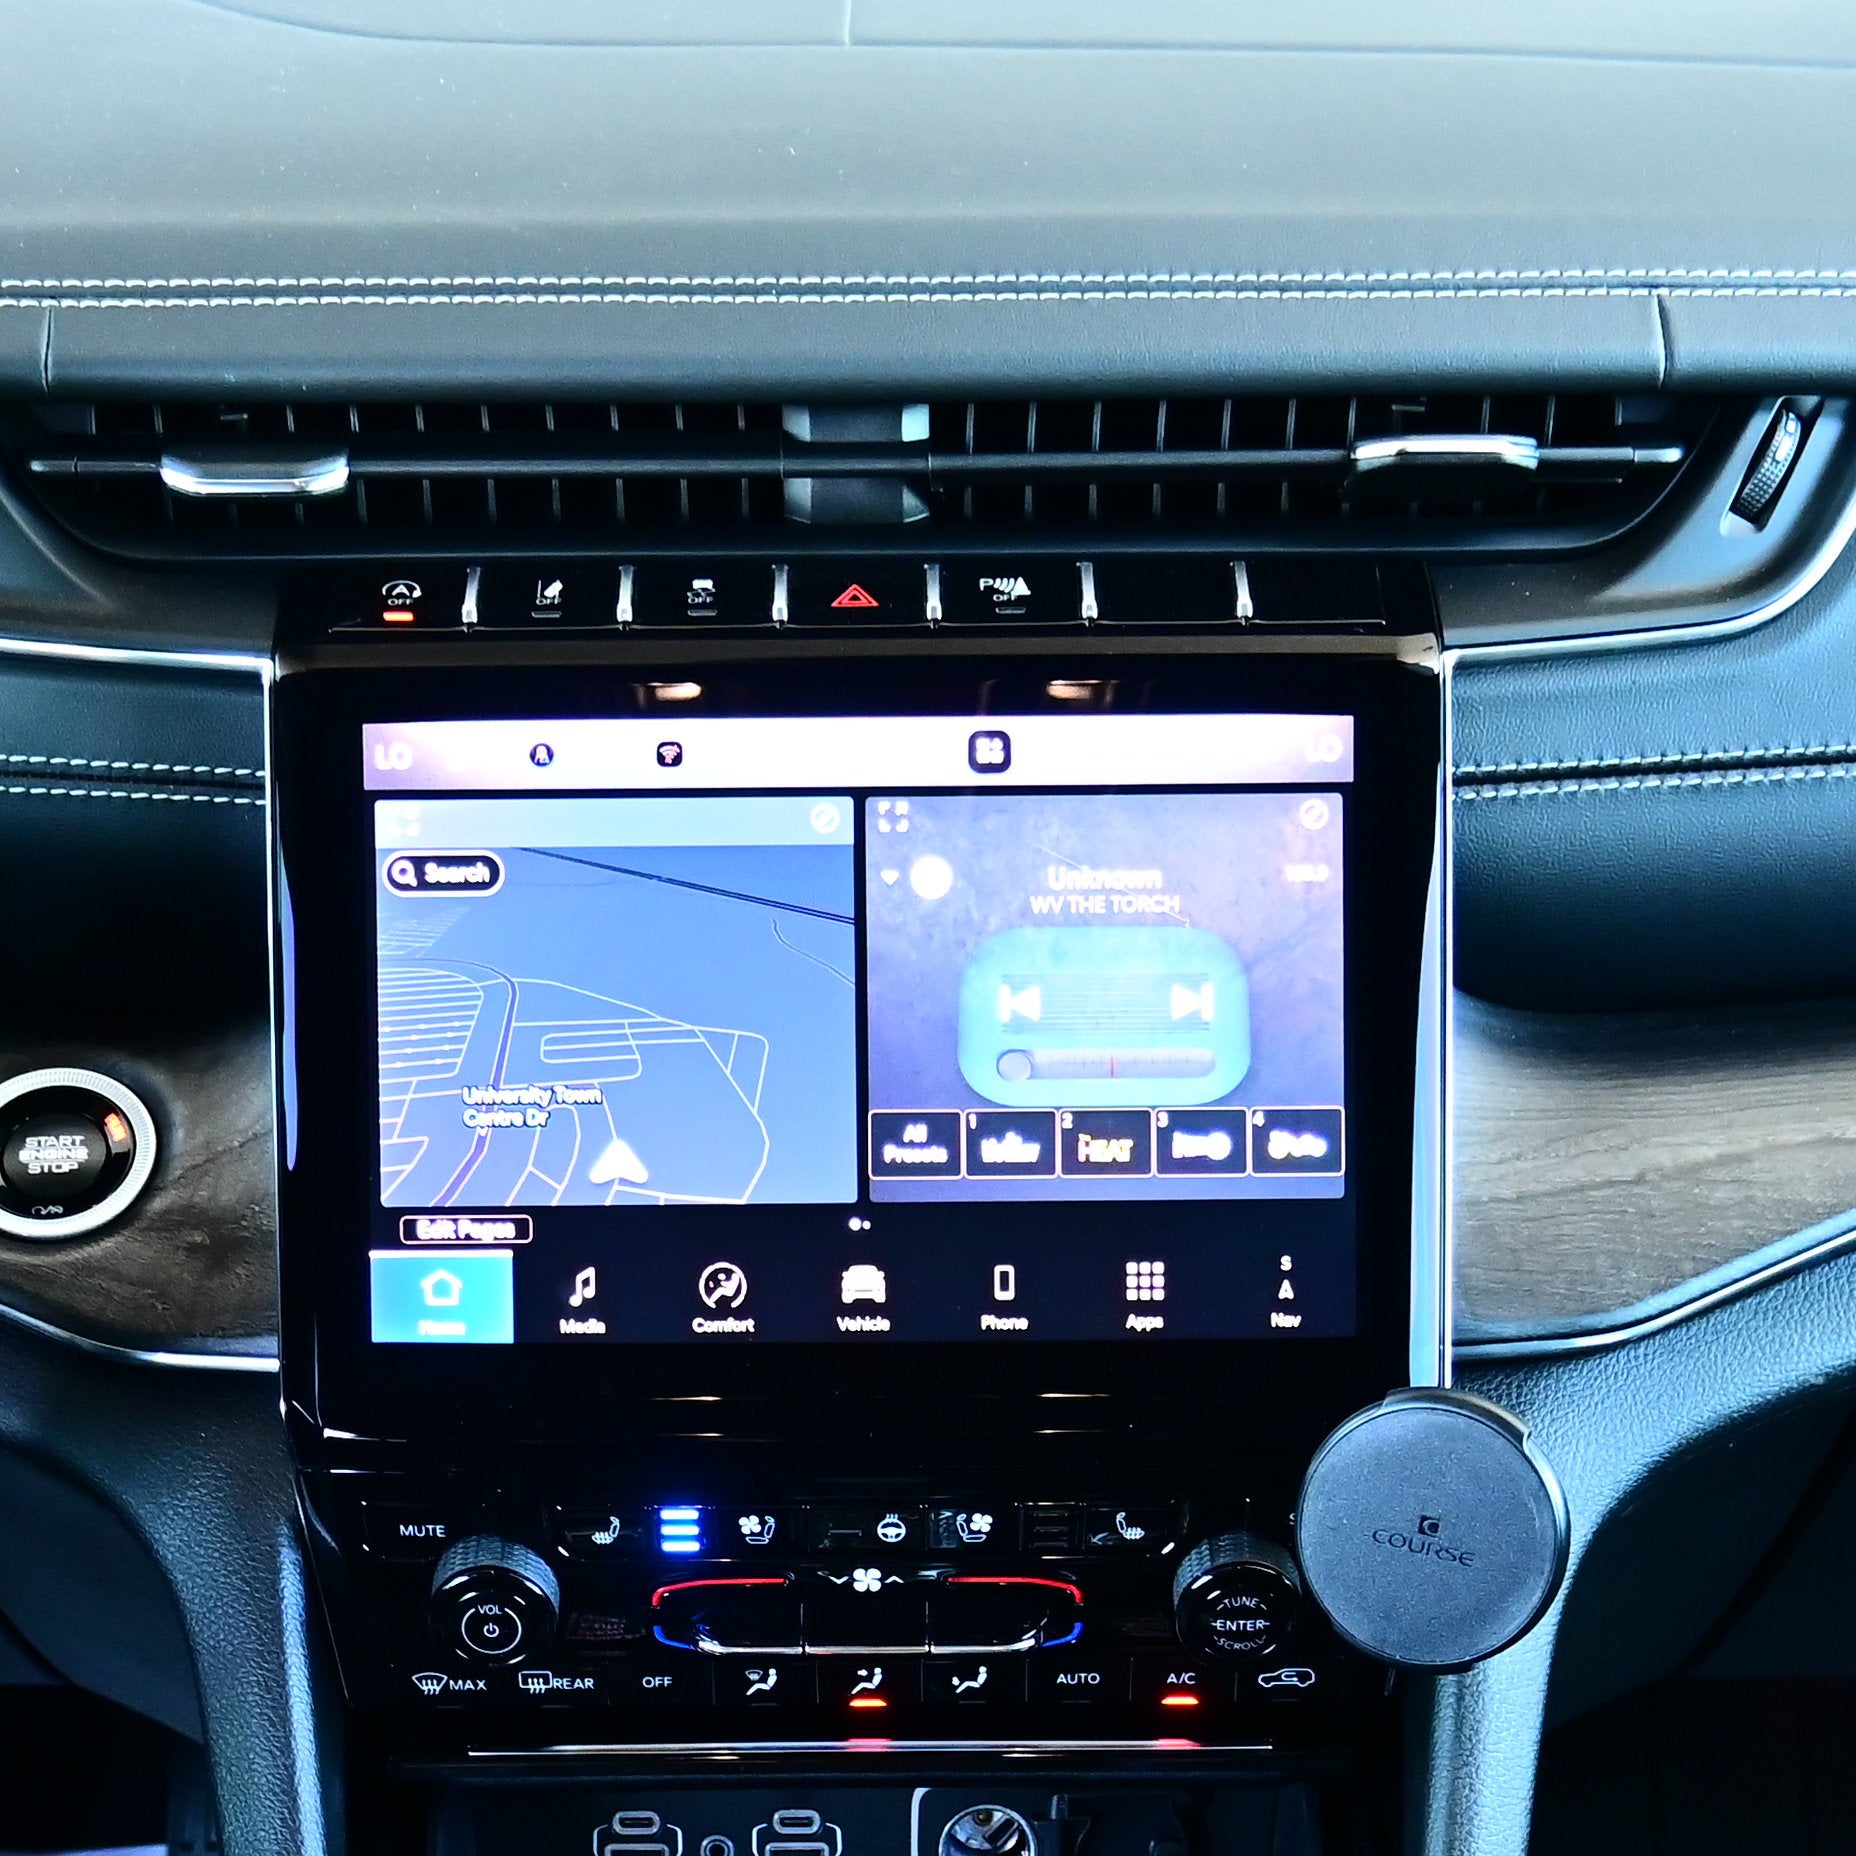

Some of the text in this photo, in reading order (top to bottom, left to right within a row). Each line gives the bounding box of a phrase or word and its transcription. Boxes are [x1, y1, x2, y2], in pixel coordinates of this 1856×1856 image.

[387, 598, 414, 606] OFF
[536, 597, 562, 606] OFF
[374, 742, 414, 772] LO
[424, 861, 491, 885] Search
[1047, 865, 1163, 891] Unknown
[1029, 894, 1181, 915] WV THE TORCH
[462, 1085, 603, 1108] University Town
[525, 1108, 550, 1127] Dr
[968, 1113, 977, 1130] 1
[1061, 1112, 1074, 1129] 2
[1157, 1111, 1169, 1128] 3
[1252, 1110, 1265, 1127] 4
[25, 1135, 85, 1148] START
[19, 1147, 88, 1163] ENGINE
[27, 1162, 79, 1174] STOP
[416, 1219, 516, 1242] Edit Pages
[559, 1318, 606, 1335] Media
[692, 1317, 755, 1334] Comfort
[836, 1315, 891, 1332] Vehicle
[980, 1314, 1029, 1331] Phone
[1125, 1313, 1164, 1332] Apps
[1270, 1312, 1302, 1328] Nav
[399, 1524, 446, 1538] MUTE
[1372, 1528, 1476, 1568] COURSE
[477, 1604, 503, 1616] VOL
[1223, 1596, 1260, 1609] TUNE
[1217, 1619, 1264, 1631] ENTER
[1217, 1637, 1265, 1650] SCROLL
[449, 1679, 487, 1691] MAX
[553, 1678, 594, 1690] REAR
[642, 1676, 673, 1688] OFF
[1057, 1672, 1101, 1685] AUTO
[1167, 1671, 1197, 1685] A/C
